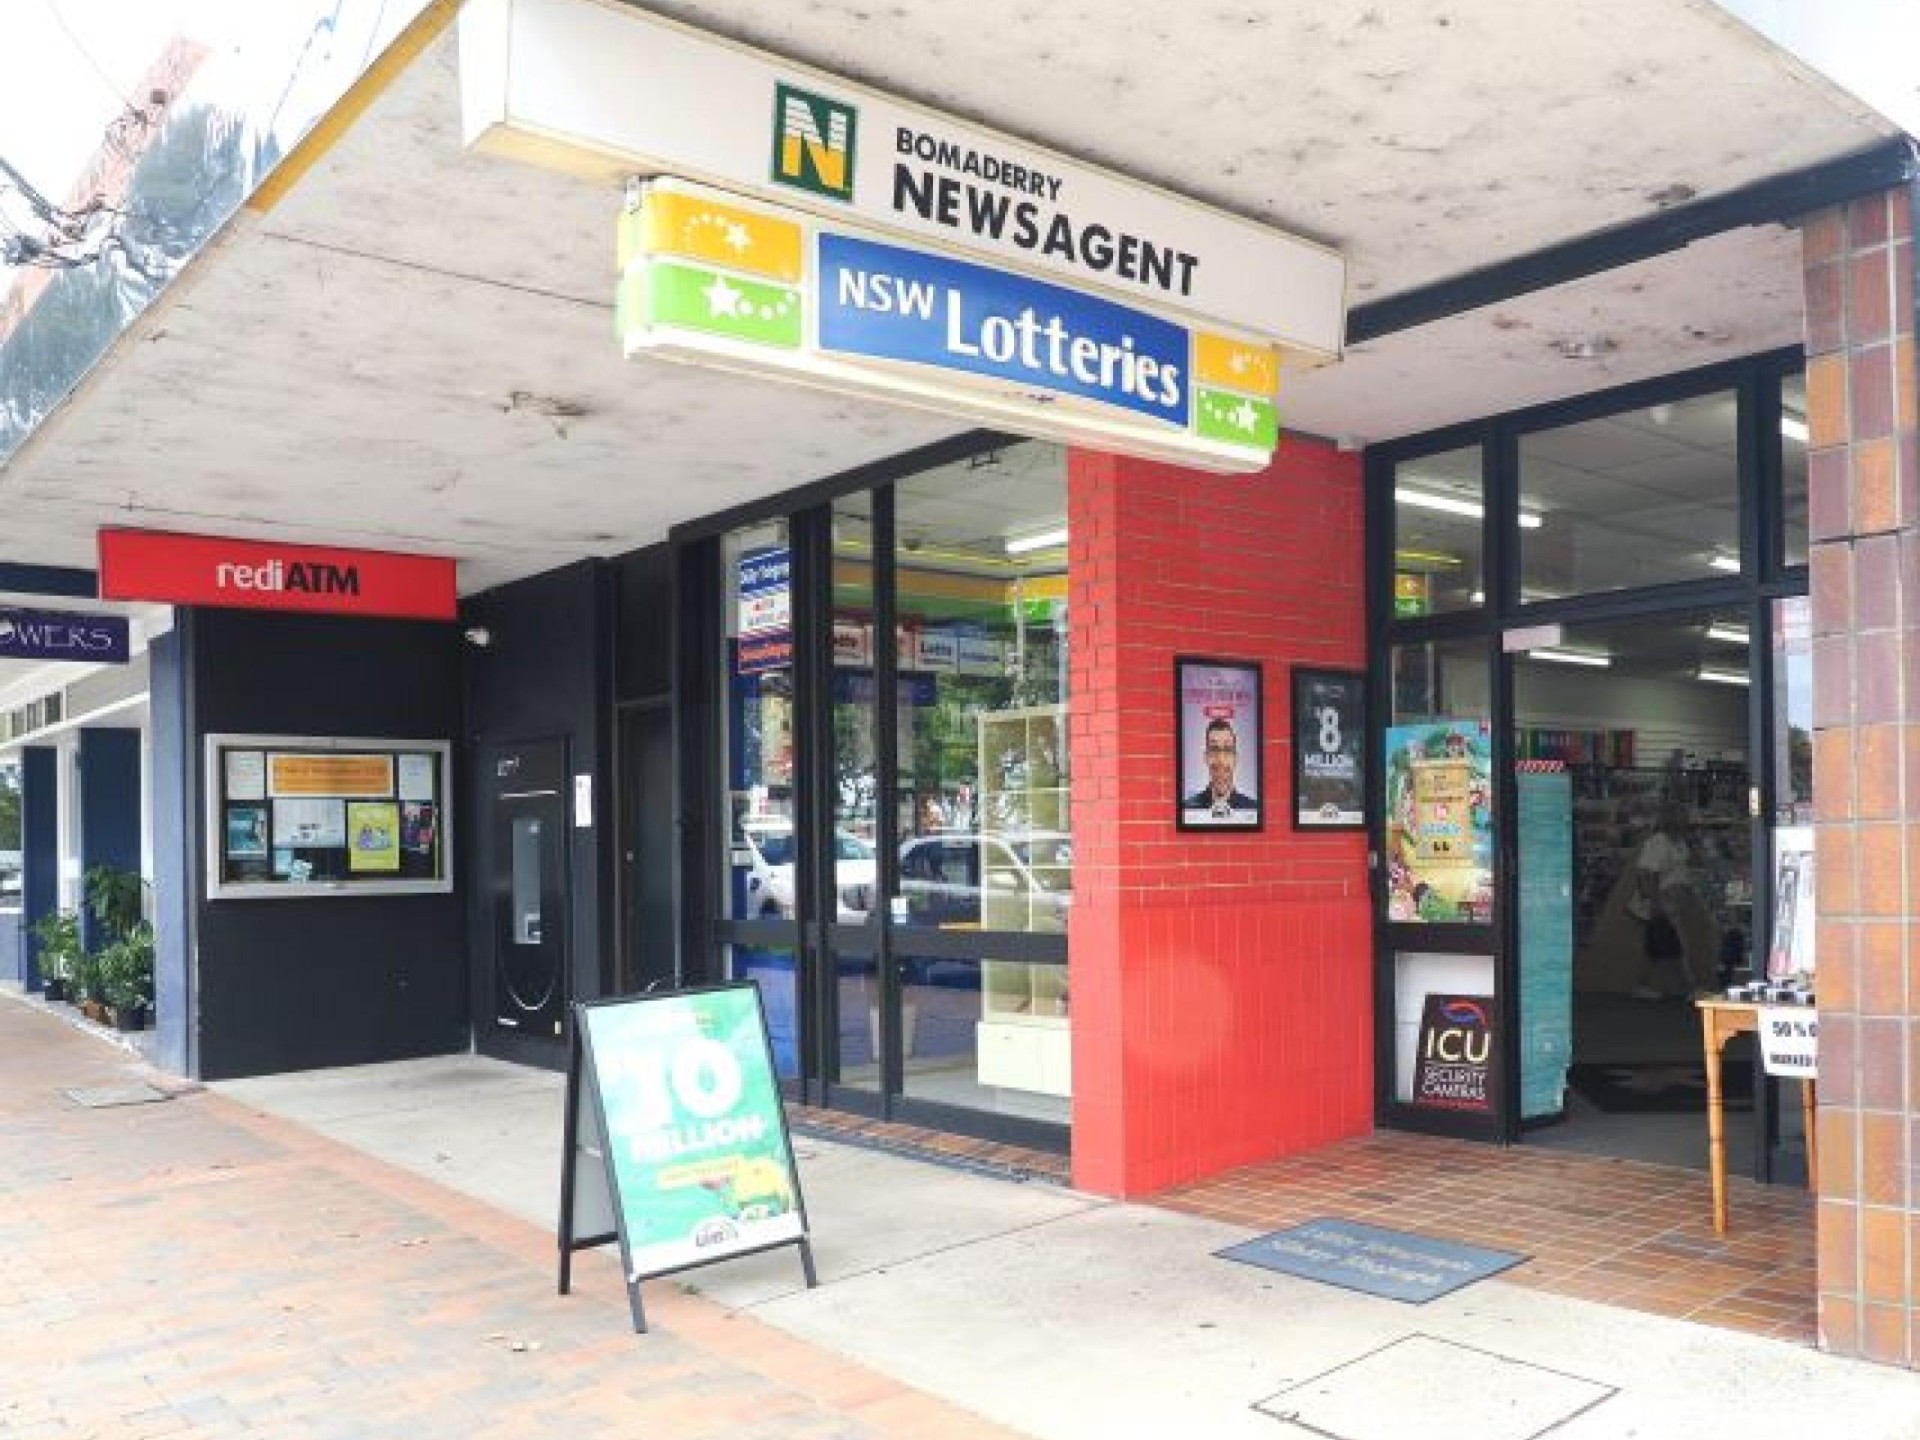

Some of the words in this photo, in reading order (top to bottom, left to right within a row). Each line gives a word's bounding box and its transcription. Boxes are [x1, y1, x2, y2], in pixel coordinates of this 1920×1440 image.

[782, 96, 848, 190] N
[896, 127, 1063, 201] BOMADERRY
[893, 163, 1200, 296] NEWSAGENT
[838, 268, 936, 321] NSW
[946, 289, 1180, 408] Lotteries
[216, 560, 360, 595] rediATM
[1425, 1026, 1491, 1062] ICU
[1421, 1083, 1486, 1100] CAMERAS
[1424, 1066, 1486, 1087] SECURITY
